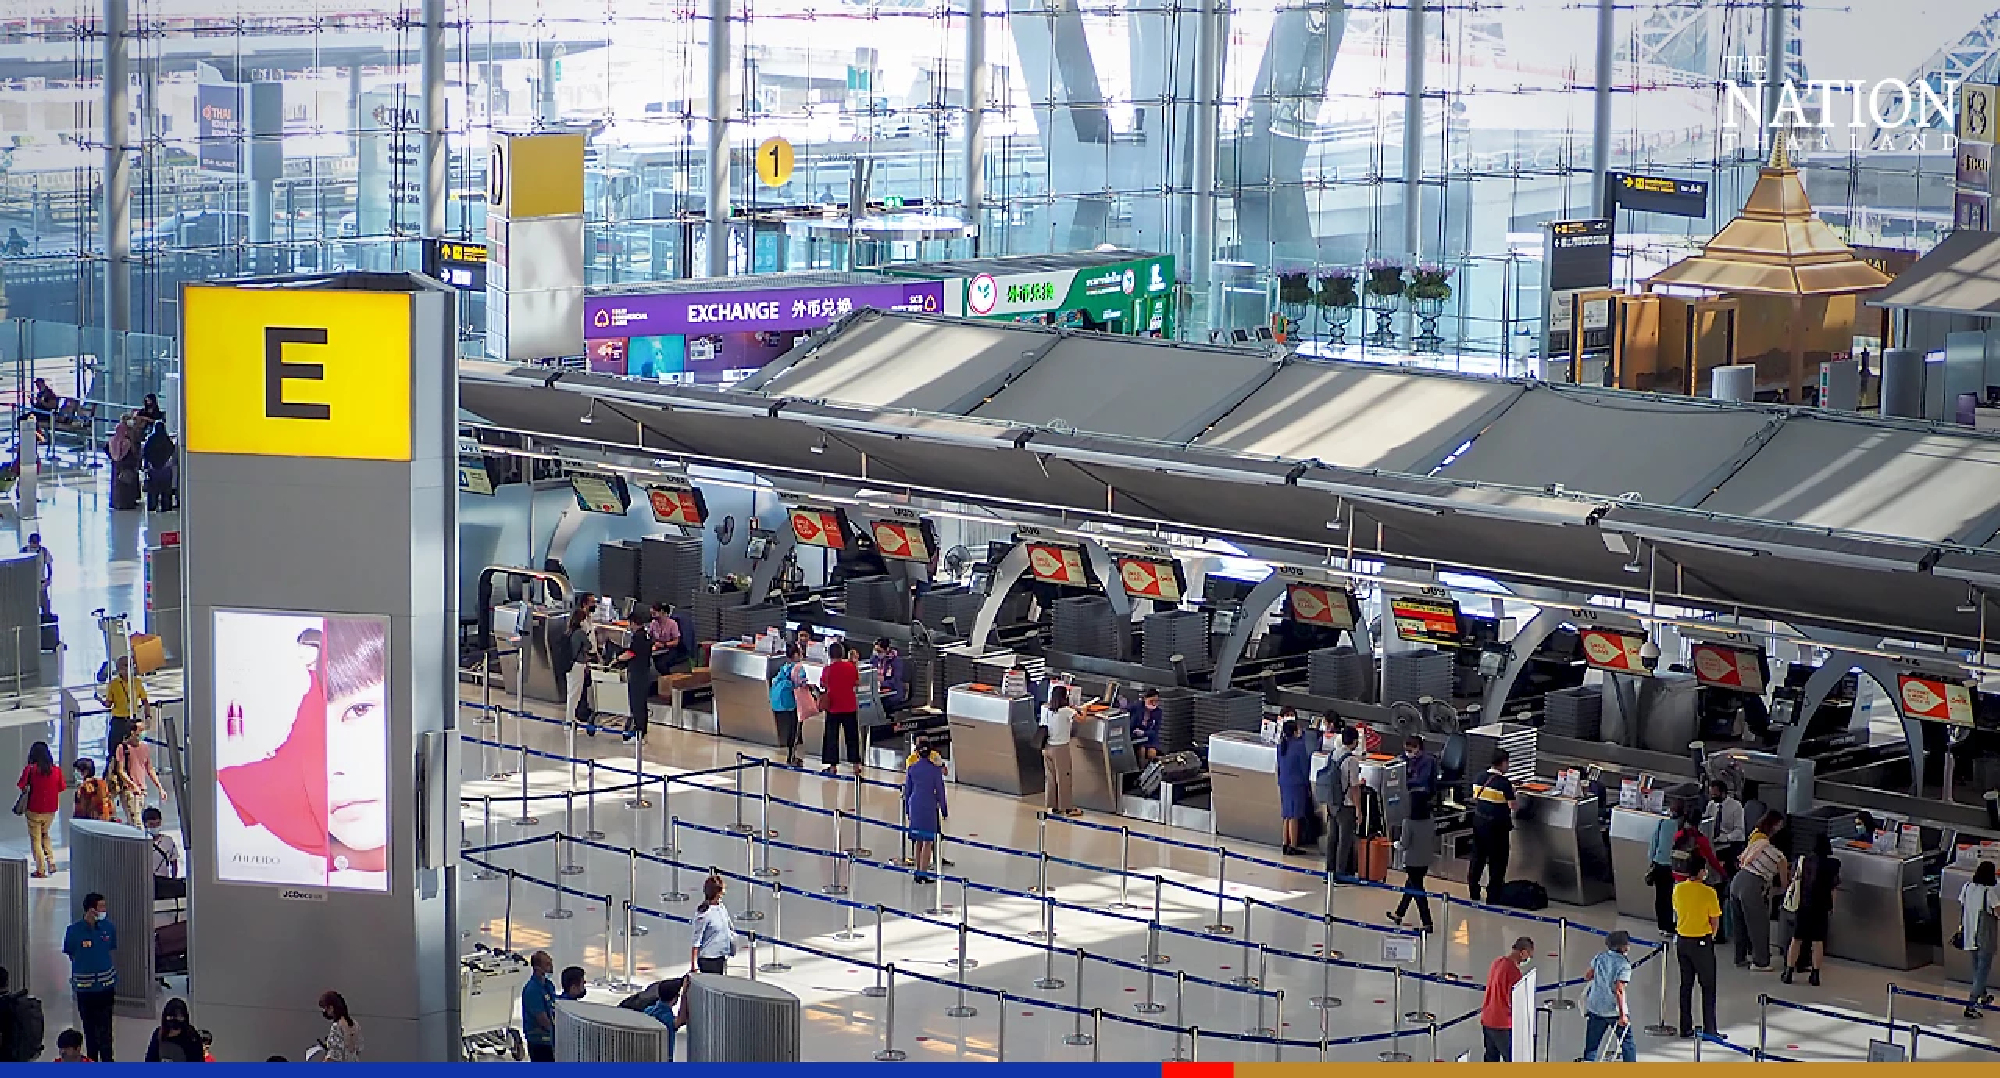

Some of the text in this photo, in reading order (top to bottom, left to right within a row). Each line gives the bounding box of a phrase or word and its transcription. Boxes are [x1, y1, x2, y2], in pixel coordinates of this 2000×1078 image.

[769, 144, 779, 178] 1
[687, 302, 780, 323] EXCHANGE
[791, 297, 853, 318] 外币兑换
[265, 326, 331, 421] E
